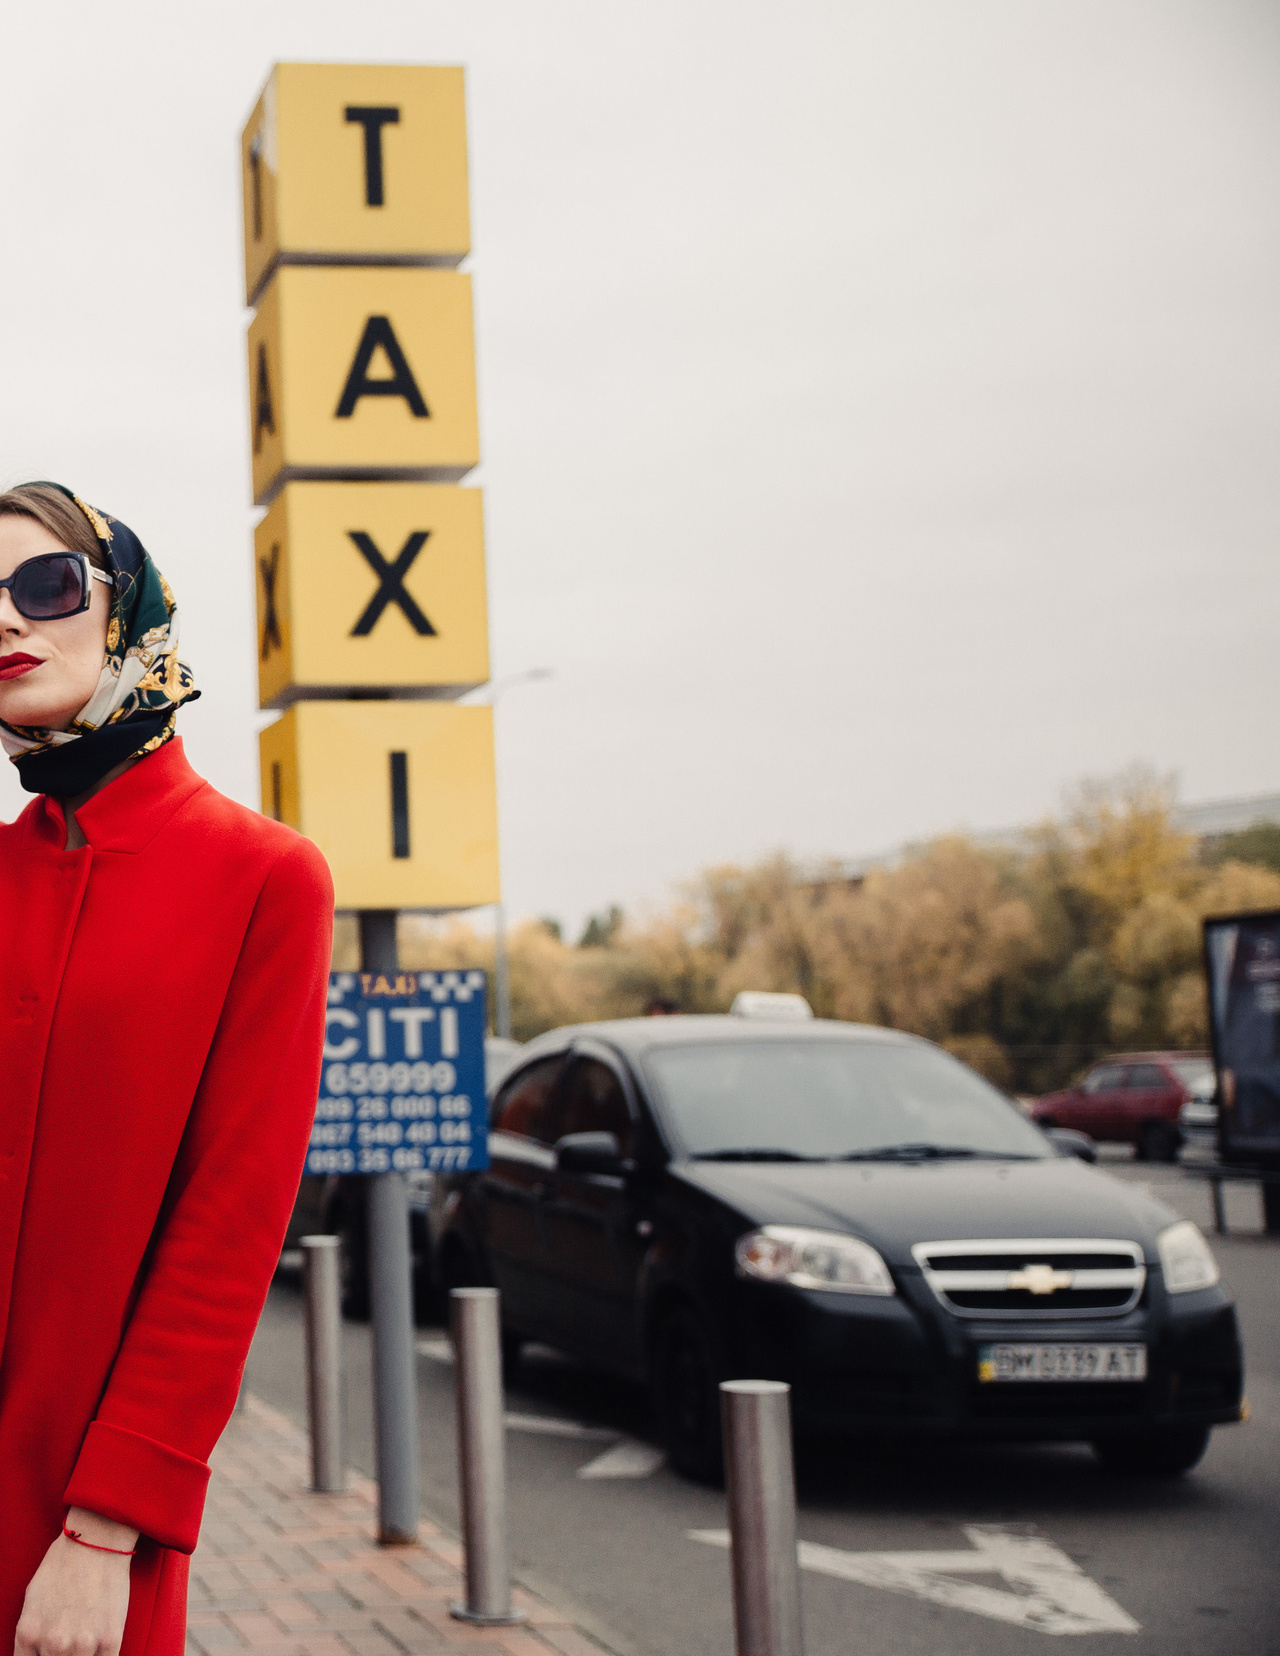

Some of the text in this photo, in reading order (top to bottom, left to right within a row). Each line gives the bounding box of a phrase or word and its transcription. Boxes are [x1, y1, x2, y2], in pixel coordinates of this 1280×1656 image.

[333, 105, 440, 860] TAXI
[323, 1006, 460, 1060] CITI
[325, 1062, 457, 1095] 659999
[426, 1146, 472, 1169] 777
